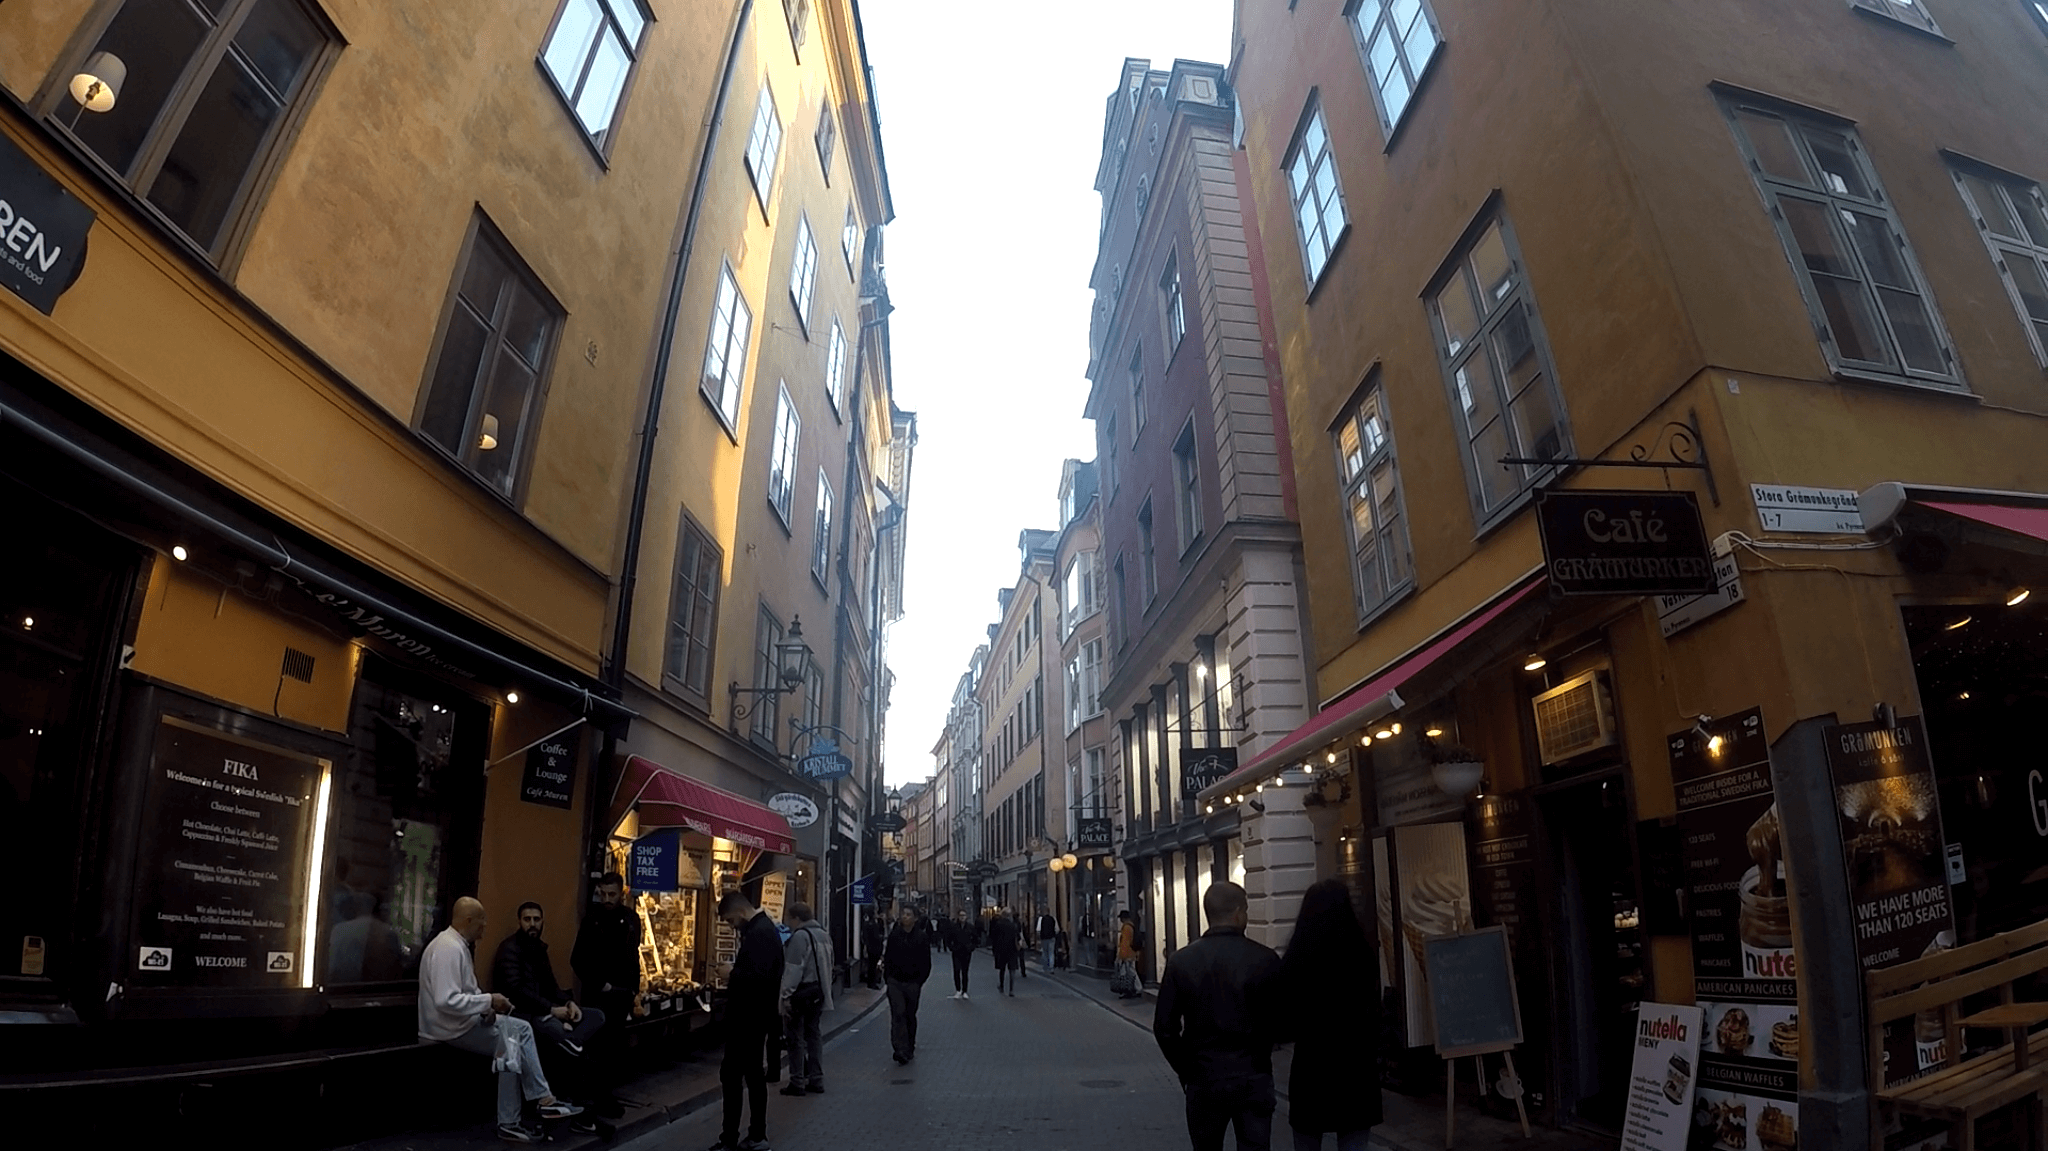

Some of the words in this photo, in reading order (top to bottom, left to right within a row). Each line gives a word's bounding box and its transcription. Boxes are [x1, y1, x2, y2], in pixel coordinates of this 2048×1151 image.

[7, 255, 26, 272] and
[24, 266, 45, 287] food
[1756, 488, 1783, 502] Stora
[1583, 507, 1669, 543] Café
[1762, 512, 1781, 527] 1-7
[1553, 552, 1711, 580] GRÅMUNKEN
[1726, 583, 1739, 601] 18
[540, 743, 568, 756] Coffee
[547, 756, 557, 767] &
[222, 759, 259, 781] FIKA
[535, 766, 568, 784] Lounge
[166, 768, 203, 786] Welcome
[212, 780, 225, 792] for
[224, 785, 231, 793] a
[255, 789, 284, 804] Swedish
[1683, 780, 1715, 796] WELCOME
[1715, 776, 1738, 788] INSIDE
[1738, 771, 1753, 783] FOR
[1753, 770, 1760, 779] A
[1679, 790, 1721, 806] TRADITIONAL
[1721, 783, 1753, 797] SWEDISH
[1752, 778, 1770, 791] FIKA
[210, 800, 235, 813] Choose
[235, 805, 261, 818] between
[1081, 833, 1110, 843] PALACE
[636, 846, 662, 856] SHOP
[636, 856, 655, 866] TAX
[636, 866, 659, 877] FREE
[1693, 883, 1722, 894] DELICIOUS
[1857, 901, 1879, 921] WE
[1879, 893, 1911, 916] HAVE
[1911, 884, 1945, 907] MORE
[1695, 908, 1722, 918] PASTRIES
[1858, 916, 1893, 939] THAN
[1893, 911, 1915, 930] 120
[1914, 901, 1949, 925] SEATS
[1698, 933, 1725, 942] WAFFLES
[195, 955, 248, 968] WELCOME
[1700, 958, 1732, 967] PANCAKES
[1862, 947, 1901, 968] WELCOME
[1697, 981, 1742, 994] AMERICAN
[1743, 982, 1794, 996] PANCAKES
[1639, 1014, 1688, 1043] nutella
[1638, 1036, 1660, 1050] MENY
[1705, 1066, 1741, 1081] BELGIAN
[1743, 1070, 1785, 1088] WAFFLES
